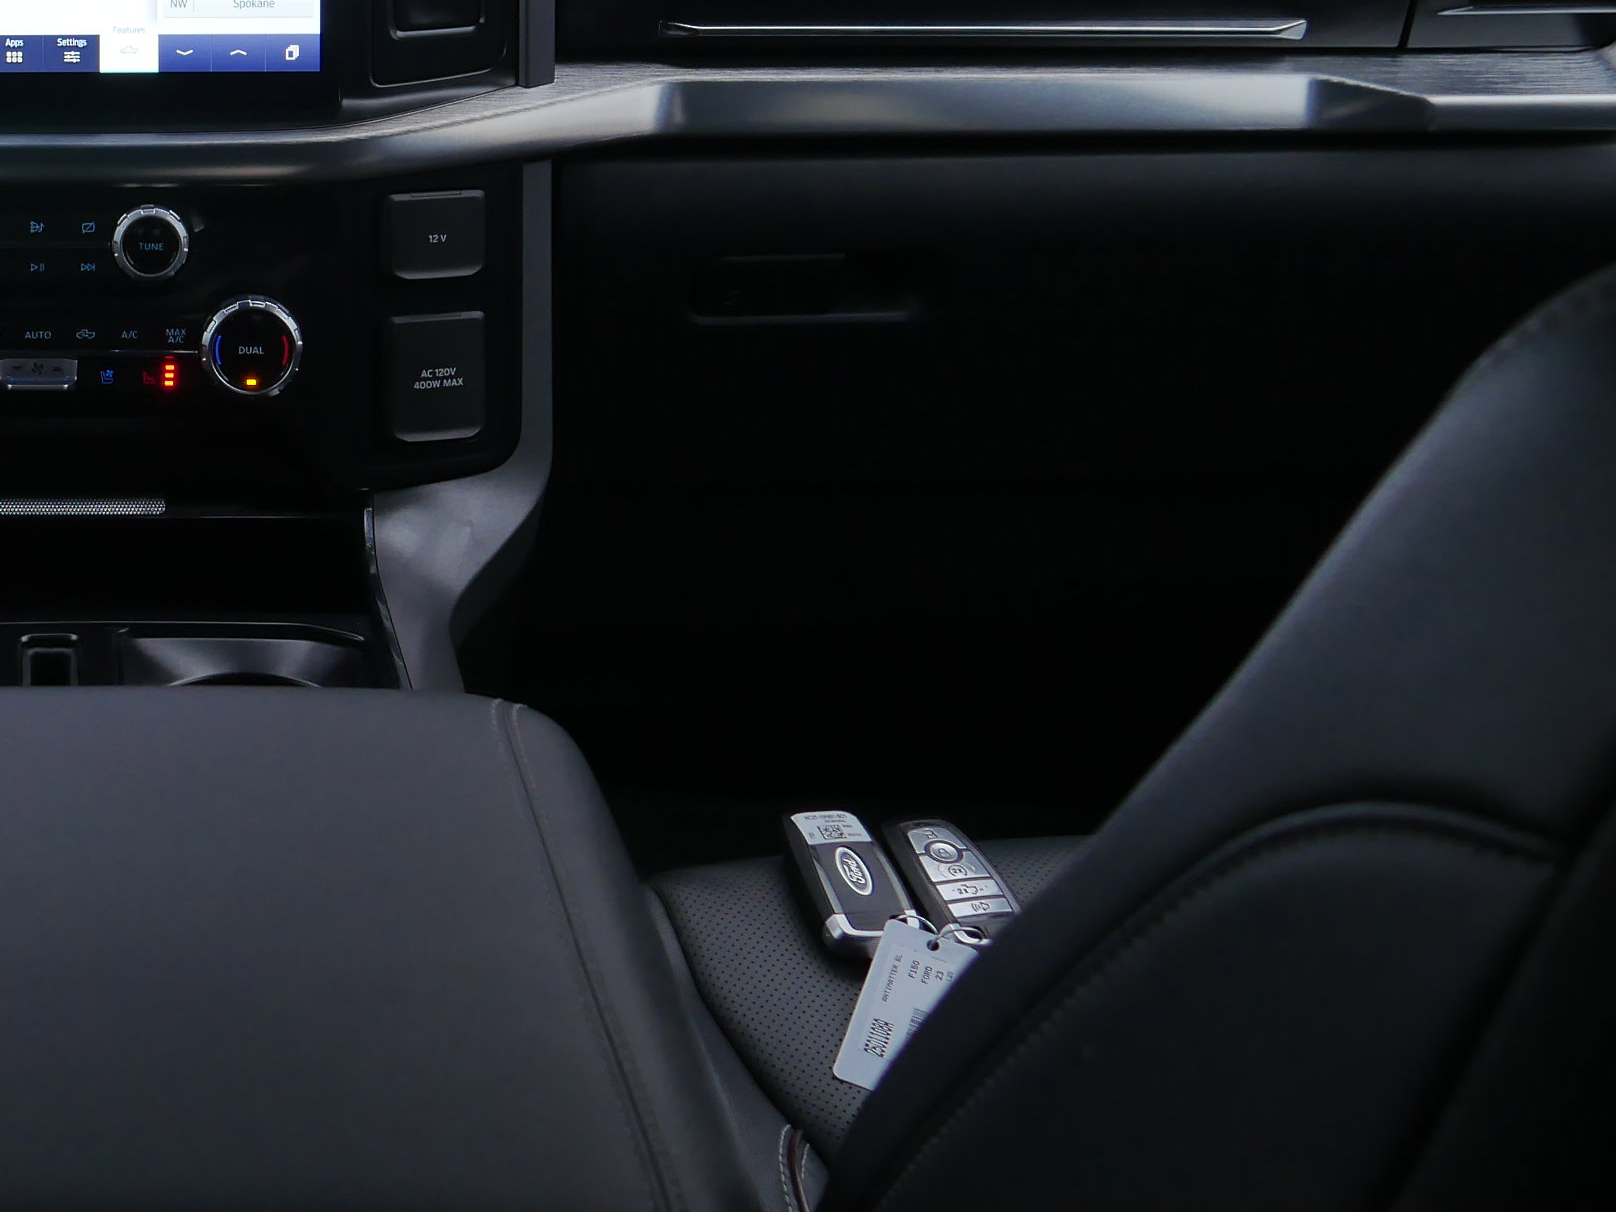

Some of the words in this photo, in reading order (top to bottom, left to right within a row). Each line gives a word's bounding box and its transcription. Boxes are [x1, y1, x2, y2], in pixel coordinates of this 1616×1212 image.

[112, 26, 146, 34] Features
[5, 38, 24, 49] Apps
[56, 37, 88, 48] Settings
[428, 234, 439, 244] 12
[439, 234, 447, 243] V
[138, 242, 165, 251] TUNE
[24, 330, 52, 340] AUTO
[121, 330, 138, 340] A/C
[165, 328, 186, 337] MAX
[167, 336, 184, 344] A/C
[238, 345, 264, 355] DUAL
[420, 369, 434, 379] AC
[434, 367, 456, 378] 120V
[413, 379, 441, 390] 400W
[443, 377, 464, 388] MAX
[908, 959, 921, 979] F150
[920, 965, 933, 985] FORD
[935, 971, 945, 981] 23
[881, 964, 900, 1003] ANTIMATTER
